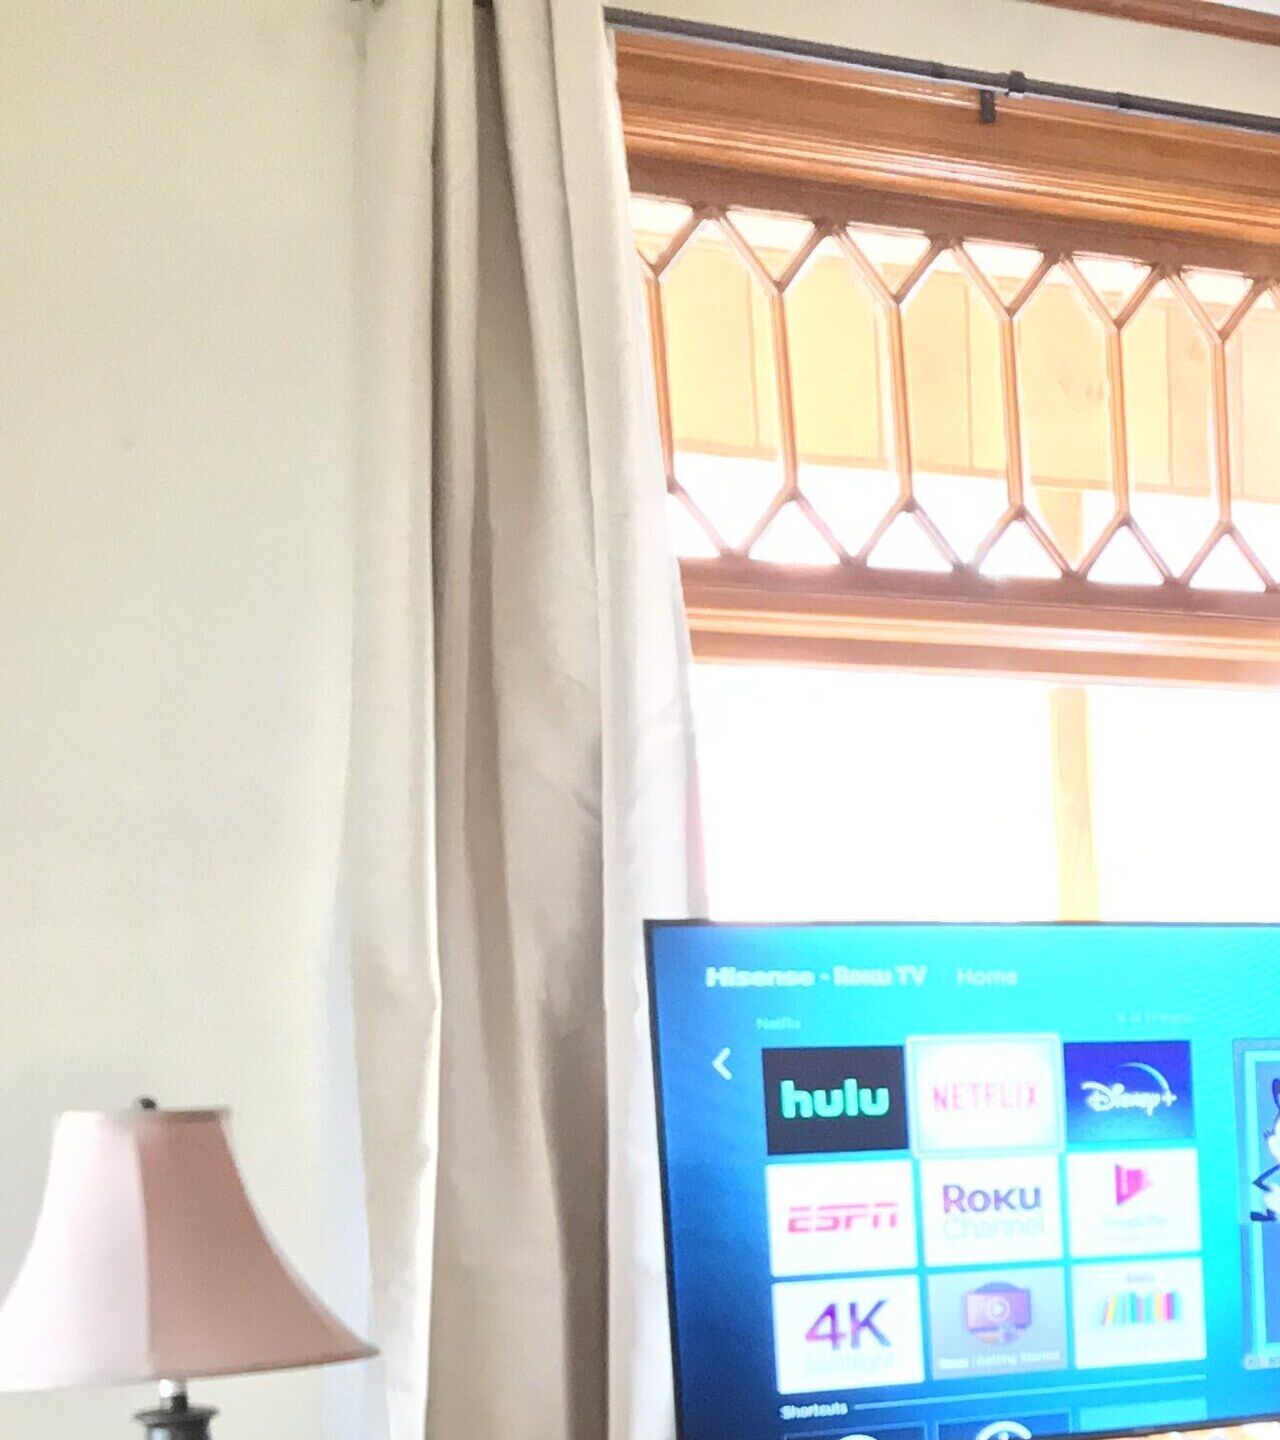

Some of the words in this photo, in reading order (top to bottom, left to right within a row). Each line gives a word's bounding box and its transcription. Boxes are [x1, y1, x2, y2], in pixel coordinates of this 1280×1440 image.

[706, 967, 815, 987] Hisense
[895, 965, 927, 986] TV
[956, 969, 1018, 986] Home
[780, 1078, 890, 1119] hulu
[931, 1080, 1041, 1114] NETFLIX
[787, 1200, 899, 1234] ESPN
[805, 1298, 891, 1350] 4K
[779, 1402, 849, 1420] Shortcuts
